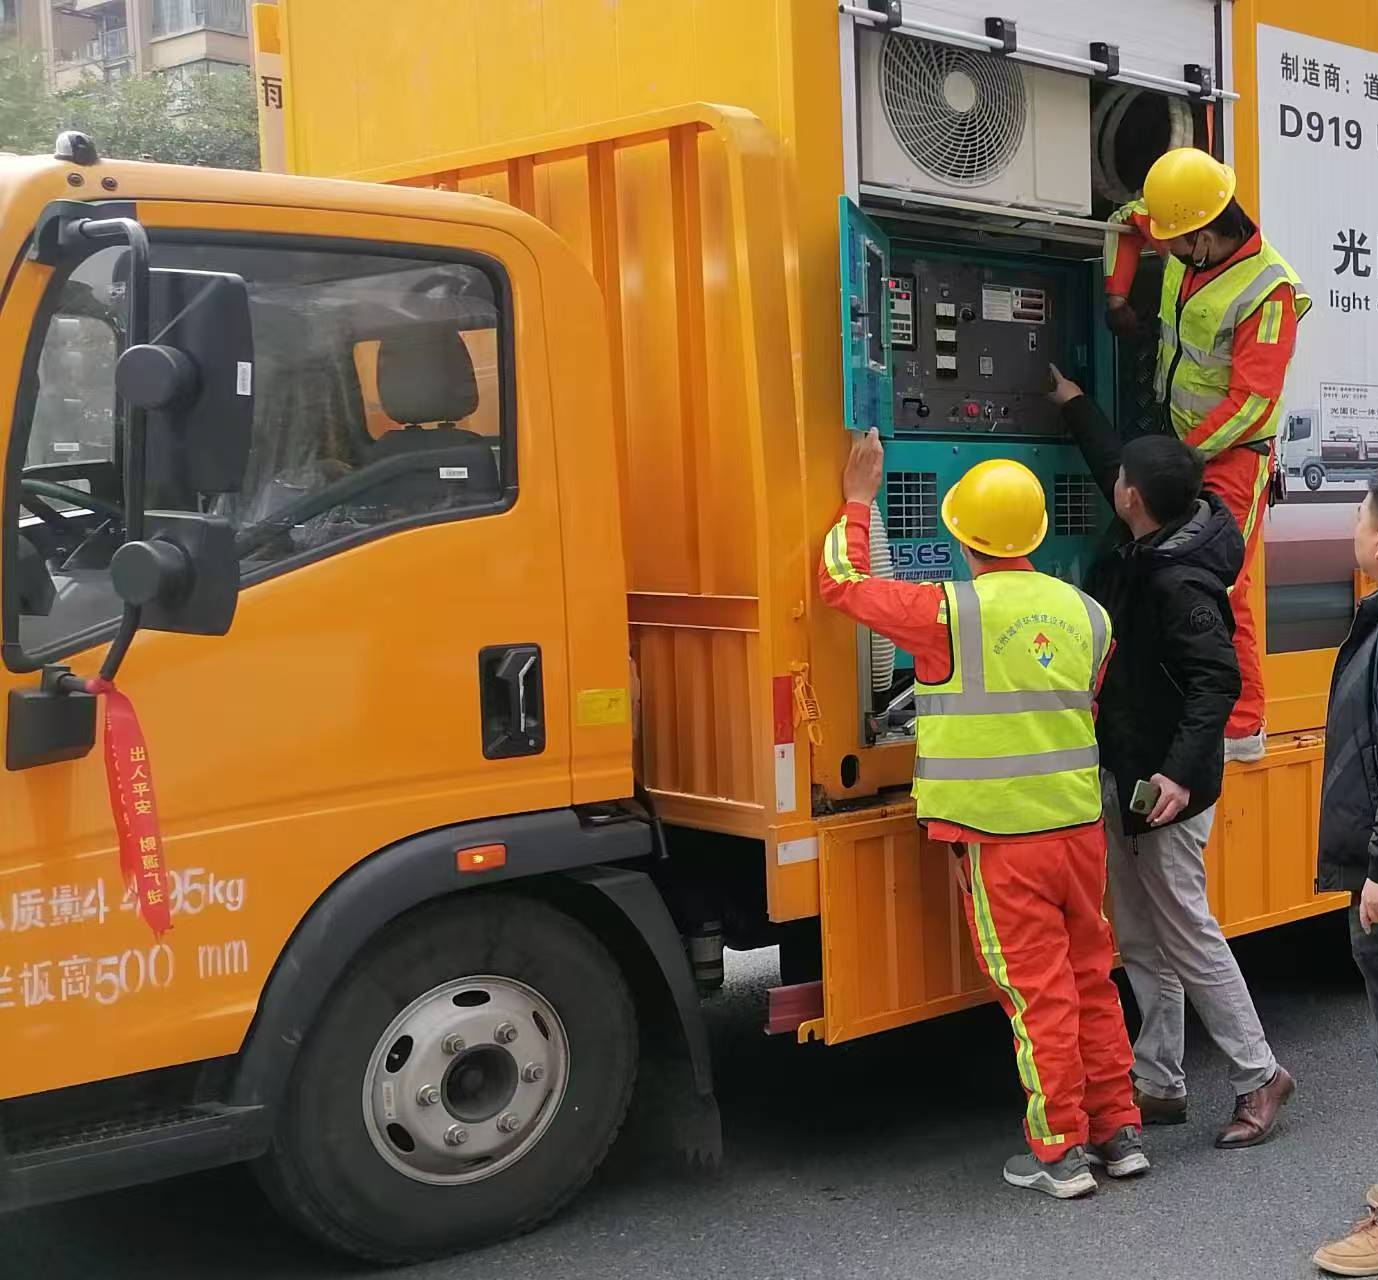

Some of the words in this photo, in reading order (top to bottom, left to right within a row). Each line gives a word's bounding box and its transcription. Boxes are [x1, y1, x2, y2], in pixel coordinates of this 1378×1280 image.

[1279, 104, 1363, 150] D919
[1329, 289, 1371, 313] light
[198, 939, 248, 979] mm
